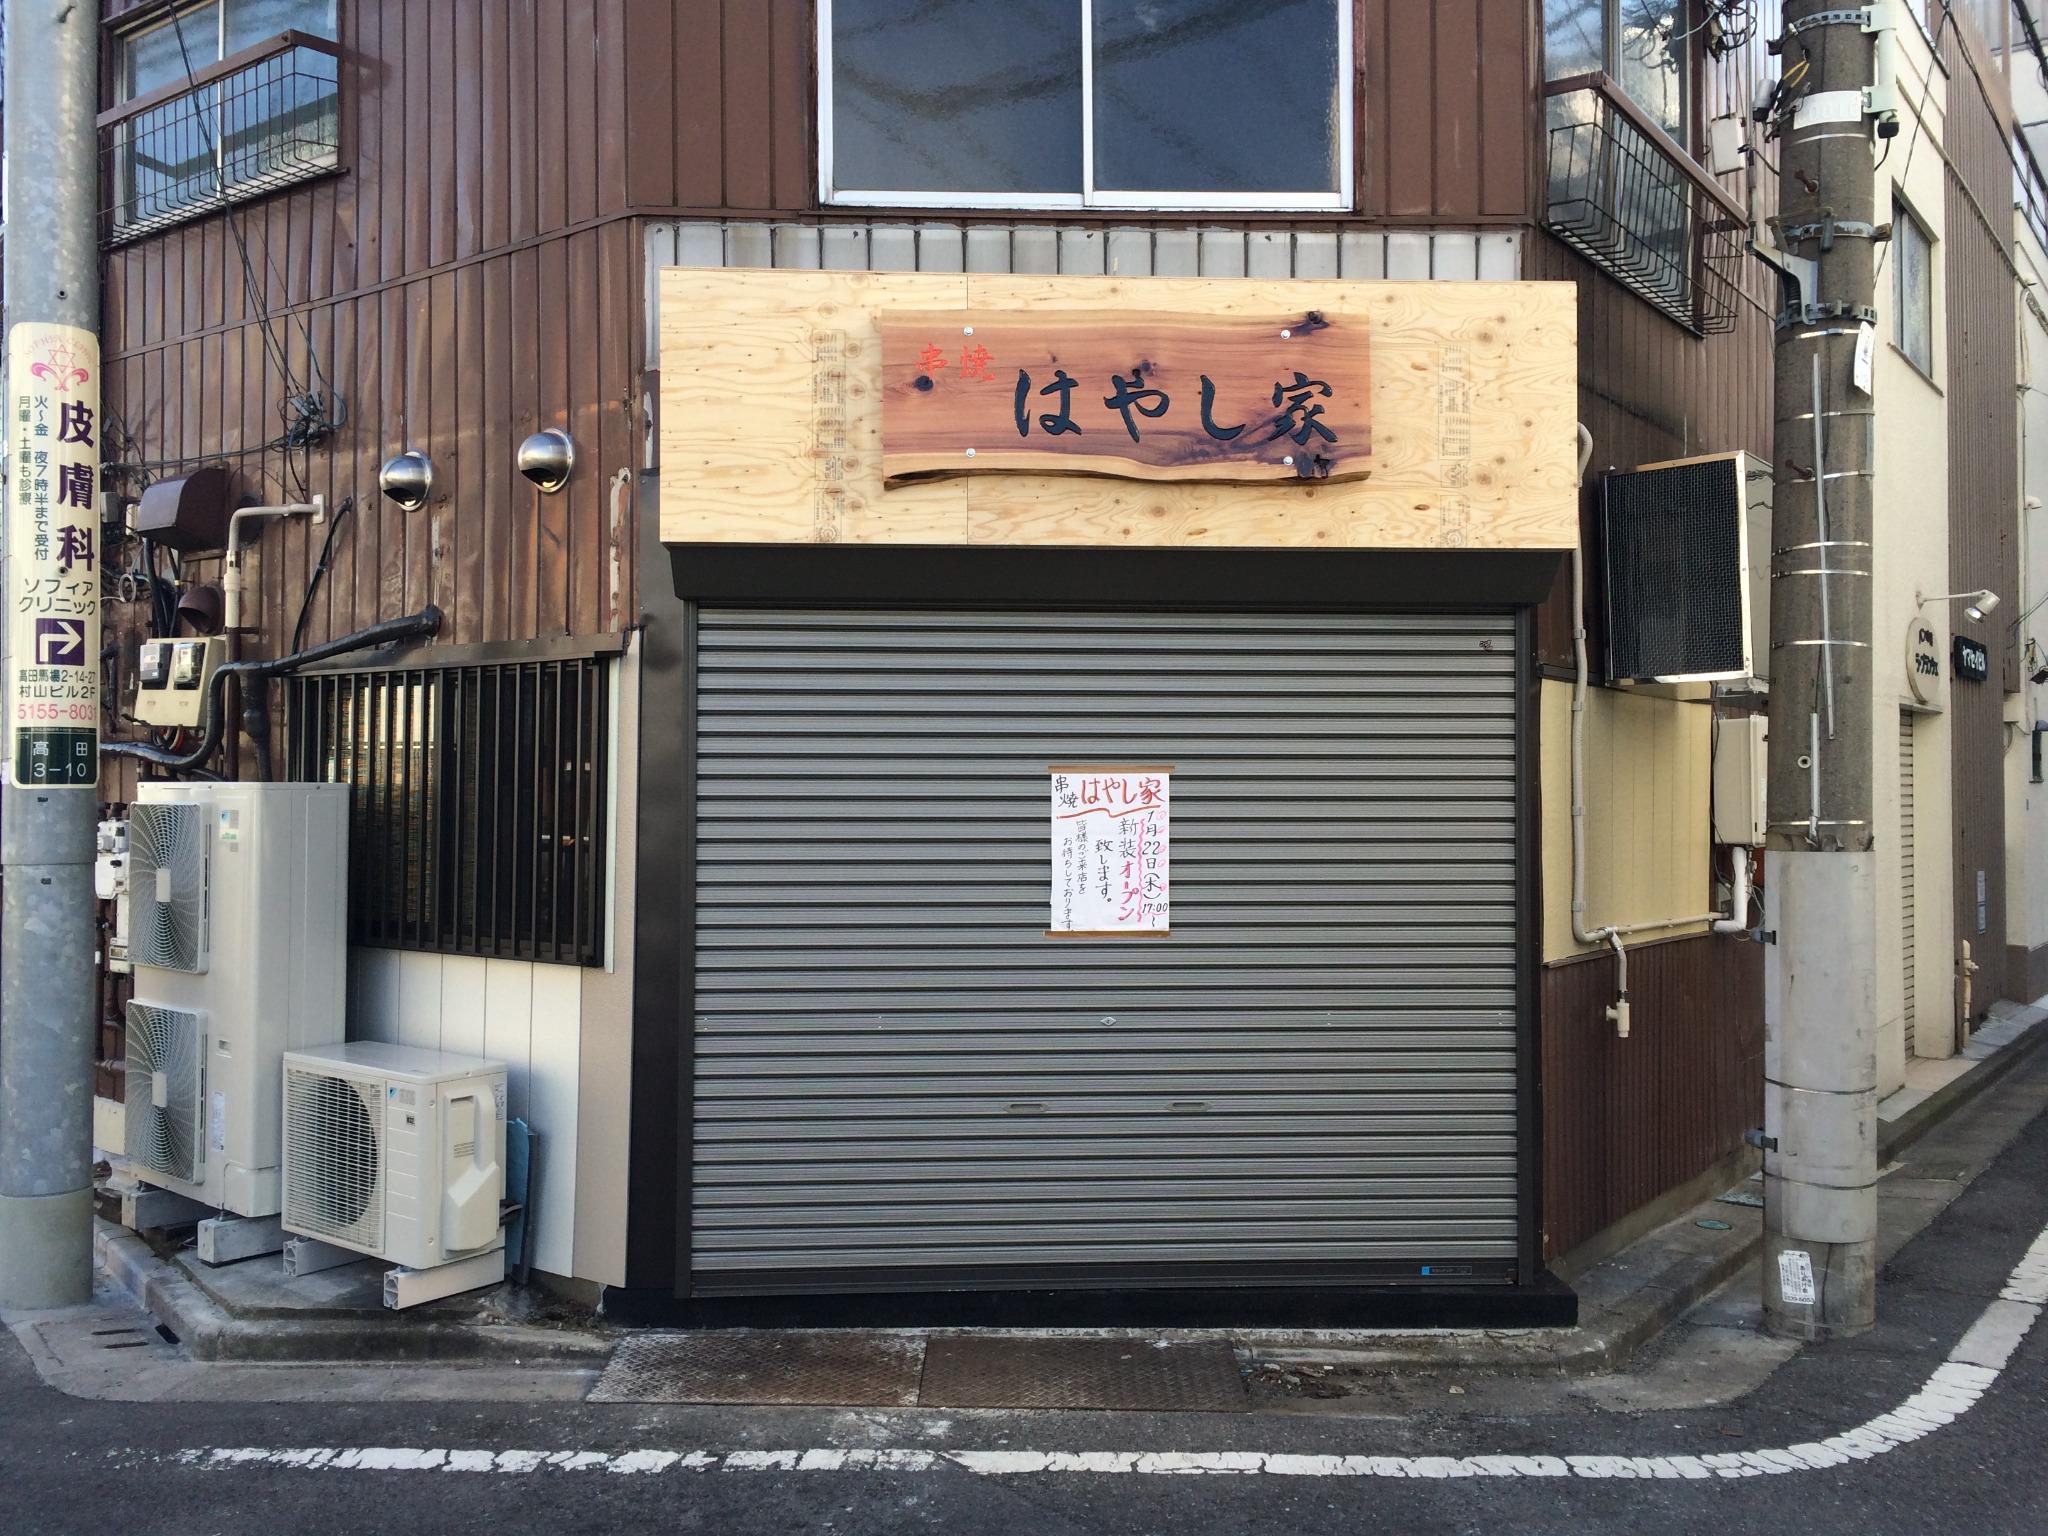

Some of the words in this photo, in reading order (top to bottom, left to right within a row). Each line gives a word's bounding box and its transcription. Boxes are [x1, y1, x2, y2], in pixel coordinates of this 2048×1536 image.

[915, 343, 996, 381] 串焼
[1013, 368, 1339, 446] はやし家
[18, 395, 32, 506] 月曜・土曜も診療
[34, 450, 49, 560] 夜7時半まで受付
[56, 399, 95, 572] 皮膚科
[18, 597, 96, 616] クリニック
[24, 578, 94, 597] ソフィア
[17, 703, 97, 721] 5155-8031
[18, 684, 96, 699] 村山ビル2F
[1054, 775, 1080, 809] 串焼
[1080, 777, 1166, 805] はやし家
[1060, 836, 1074, 930] お待ちしております
[1076, 819, 1089, 895] 皆様のご来店を
[1118, 817, 1140, 921] 新装オープン
